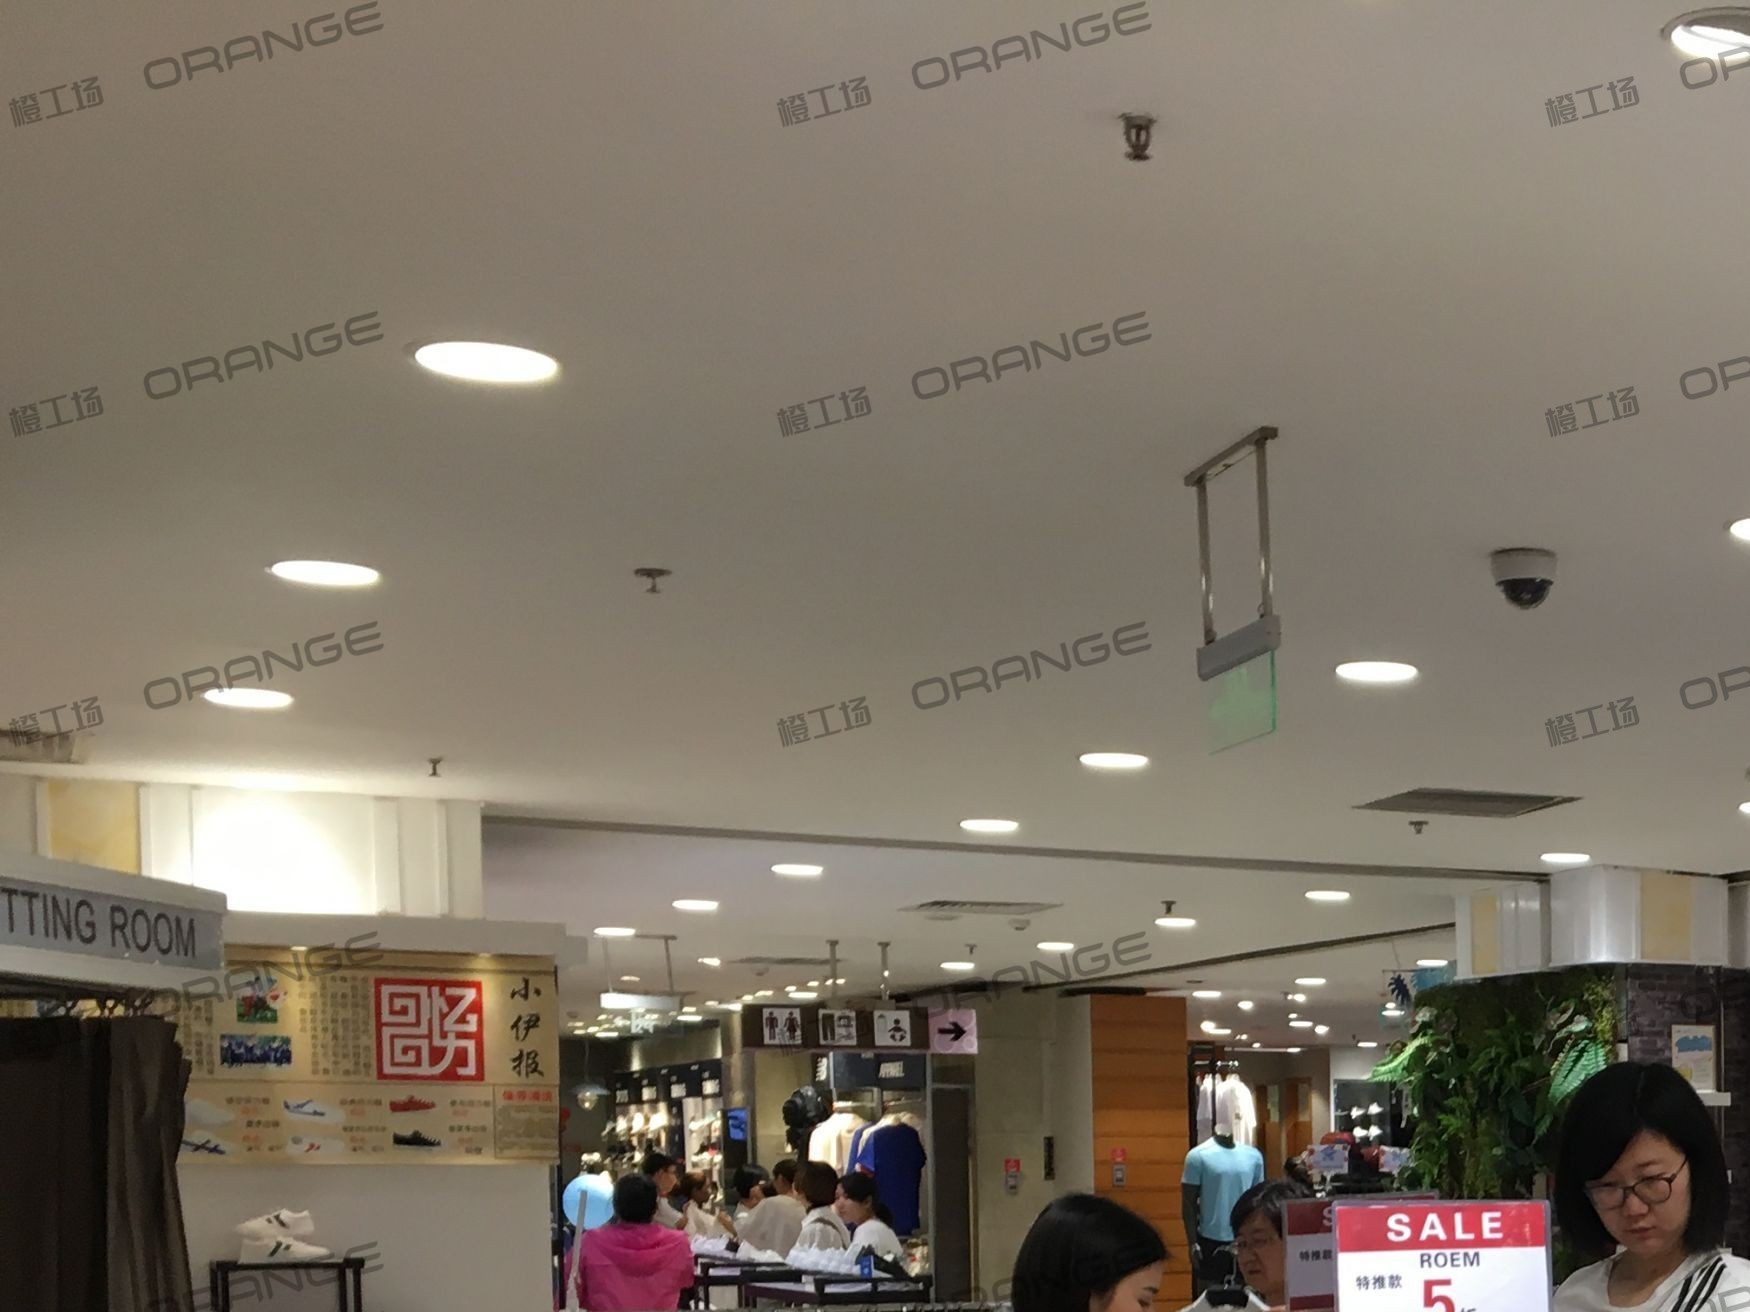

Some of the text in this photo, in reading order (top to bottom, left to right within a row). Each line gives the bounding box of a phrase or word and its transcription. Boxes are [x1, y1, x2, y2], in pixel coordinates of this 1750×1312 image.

[1, 887, 197, 959] TTING ROOM
[510, 976, 546, 1079] 小伊报
[1386, 1211, 1504, 1242] SALE
[1420, 1251, 1481, 1268] ROEM
[1355, 1274, 1403, 1291] 特推款
